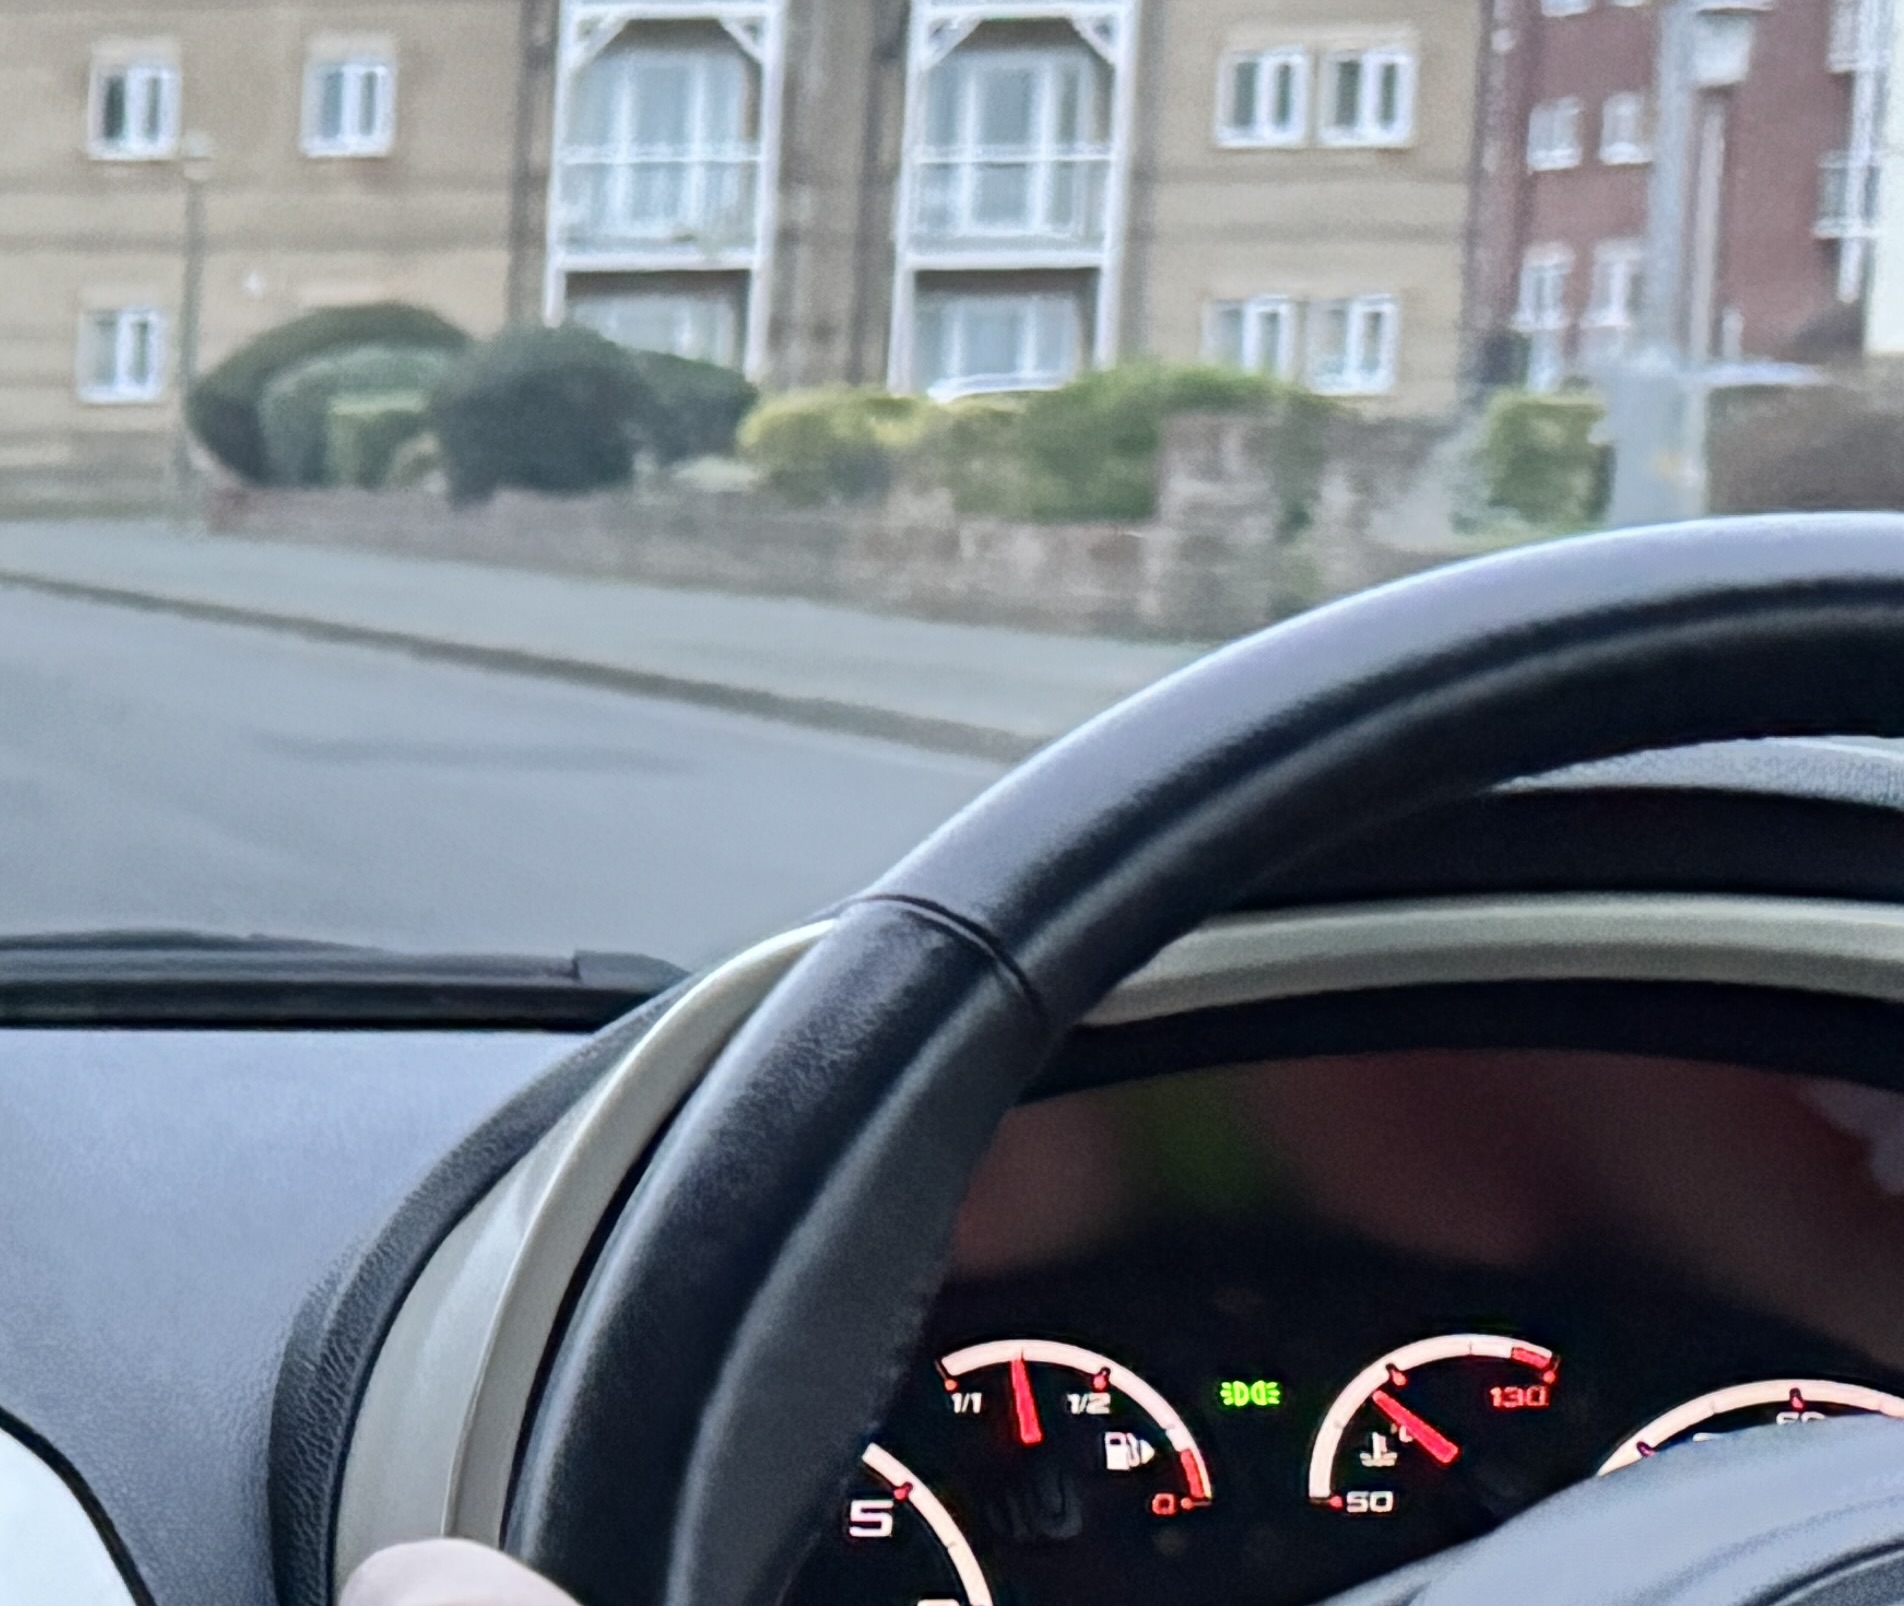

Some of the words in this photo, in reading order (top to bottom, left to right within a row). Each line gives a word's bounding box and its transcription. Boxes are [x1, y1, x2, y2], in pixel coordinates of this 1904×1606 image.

[951, 1392, 982, 1415] 1/1
[1067, 1392, 1112, 1415] 1/2
[1490, 1386, 1549, 1408] 130
[1152, 1492, 1178, 1516] 0
[1346, 1490, 1394, 1513] 50
[849, 1499, 894, 1538] 5
